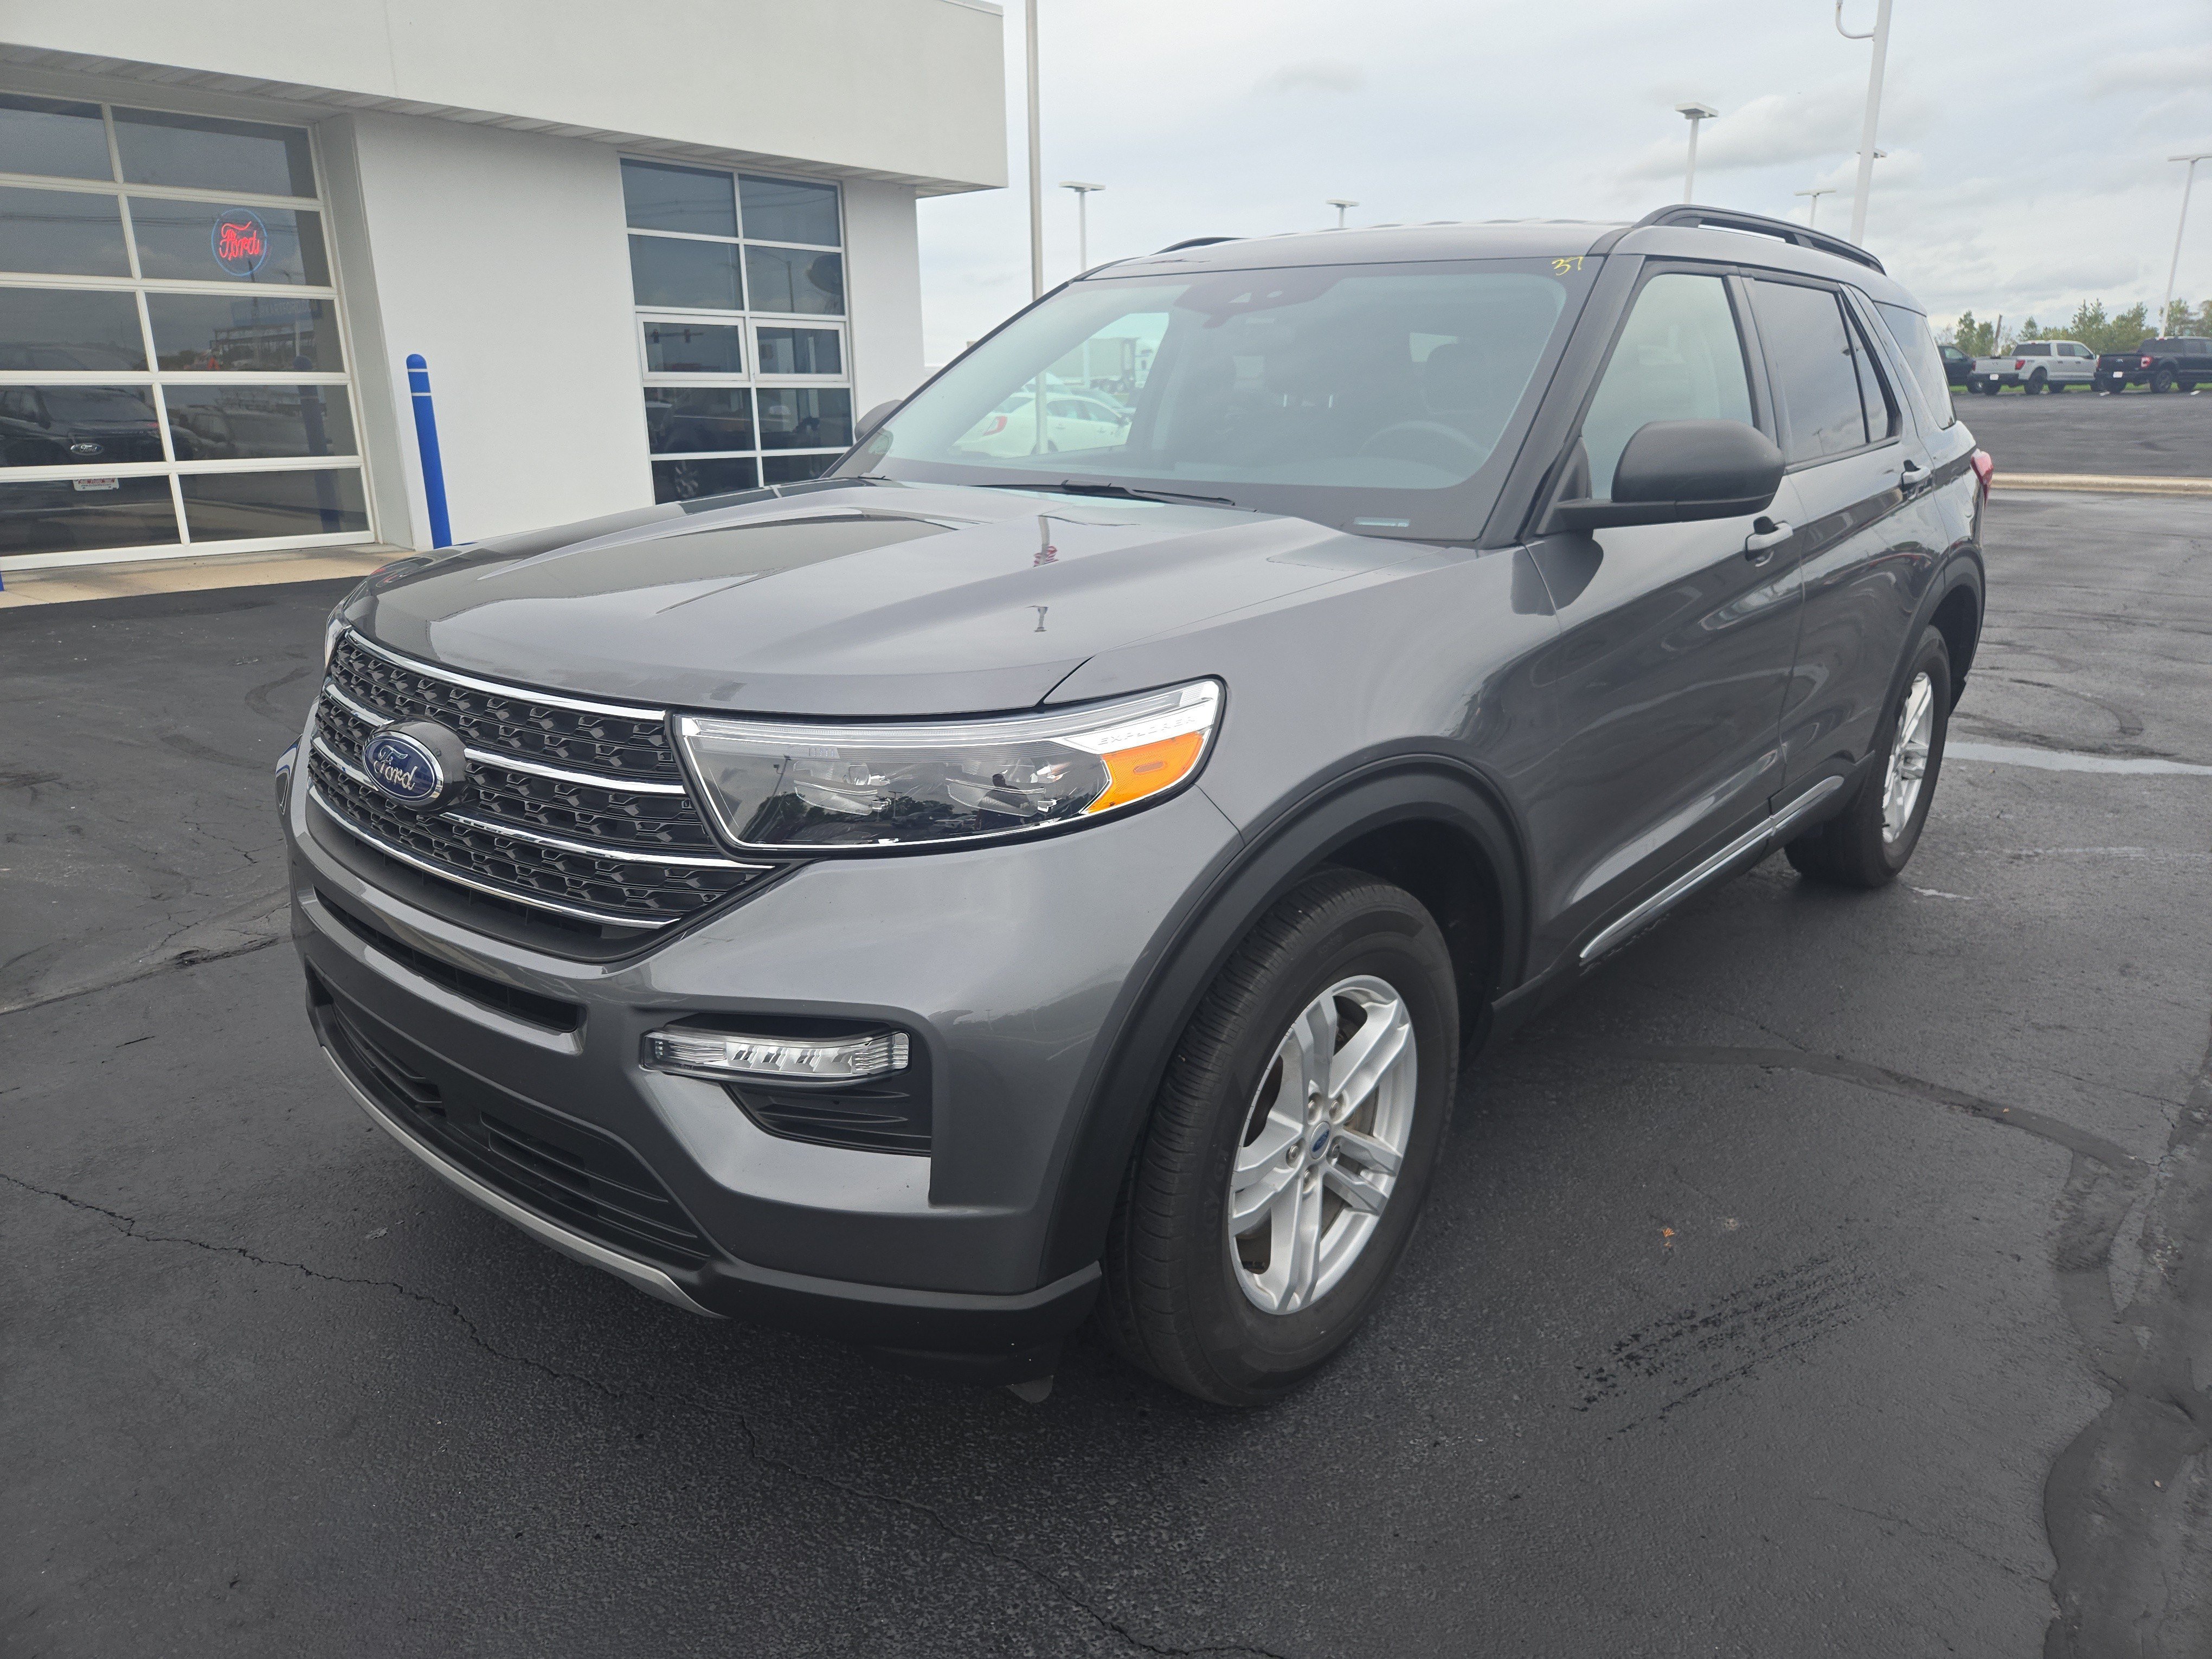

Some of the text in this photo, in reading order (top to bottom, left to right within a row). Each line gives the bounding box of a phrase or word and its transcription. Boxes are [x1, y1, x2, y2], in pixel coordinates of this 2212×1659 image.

[219, 215, 260, 261] Ford
[1551, 256, 1584, 276] 37
[1098, 716, 1197, 745] EXPLORER
[372, 744, 418, 790] Ford
